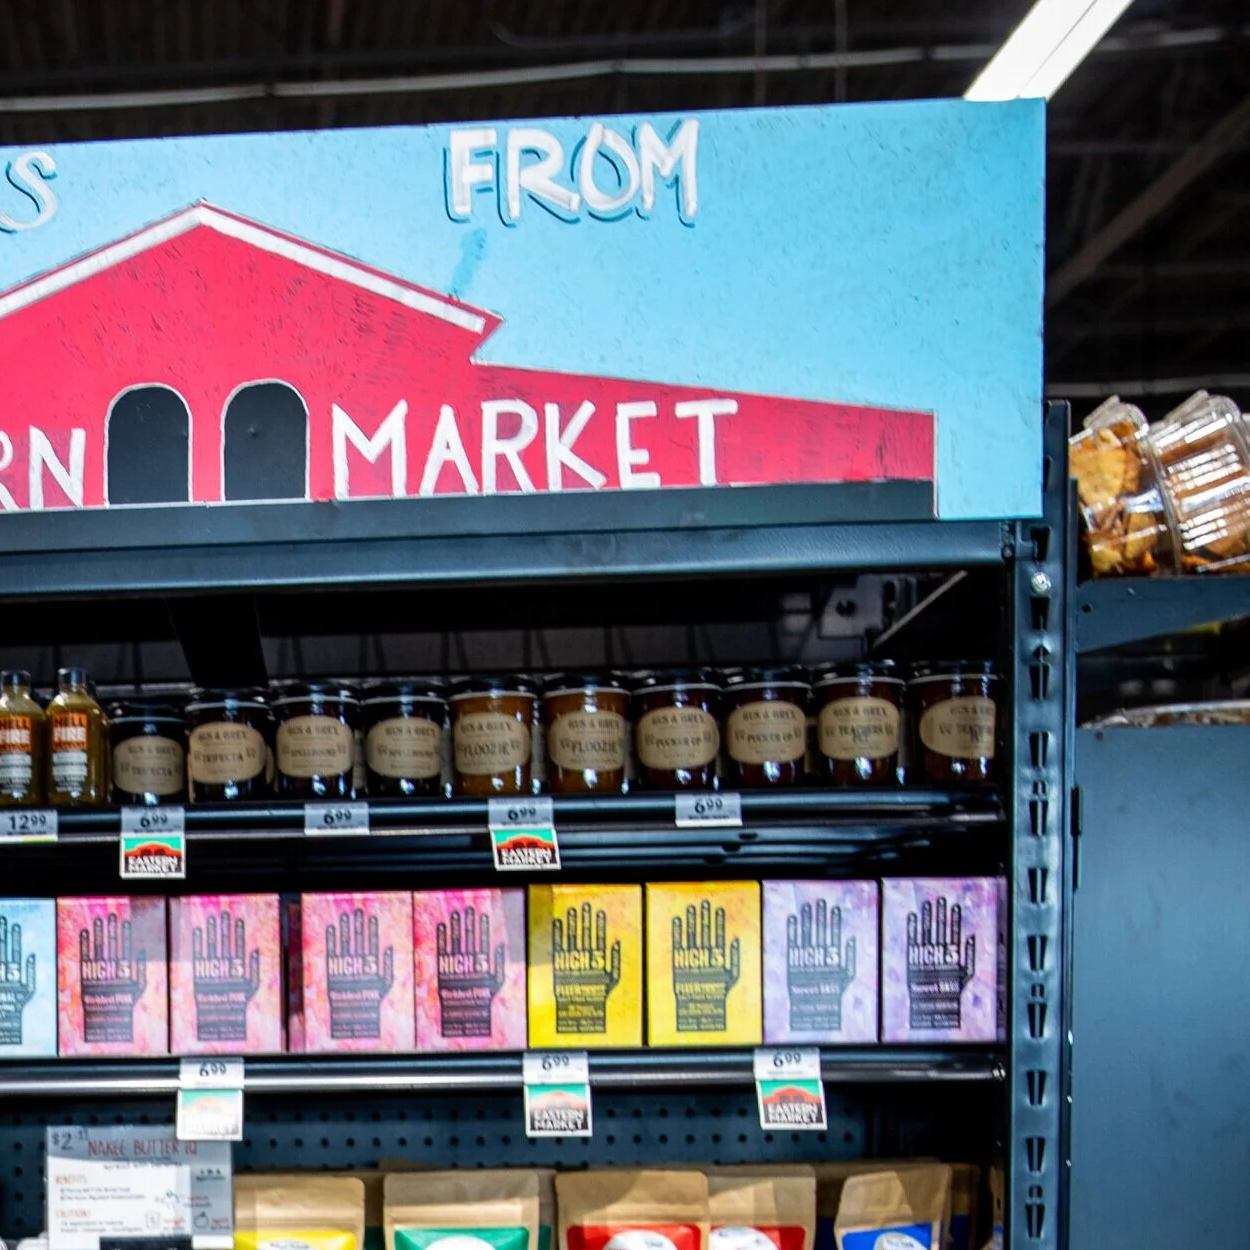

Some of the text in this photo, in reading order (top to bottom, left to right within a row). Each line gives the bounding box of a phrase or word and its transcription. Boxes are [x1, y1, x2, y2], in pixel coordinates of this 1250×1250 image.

[444, 118, 700, 227] FROM
[331, 398, 739, 500] MARKET
[54, 727, 86, 742] FIRE
[439, 954, 488, 973] HIGH 5
[555, 950, 605, 970] HIGH 5
[789, 947, 840, 967] HIGH 5
[909, 945, 959, 965] HIGH 5
[7, 963, 21, 981] 5
[82, 962, 130, 980] HIGH 5
[195, 960, 244, 978] HIGH 5
